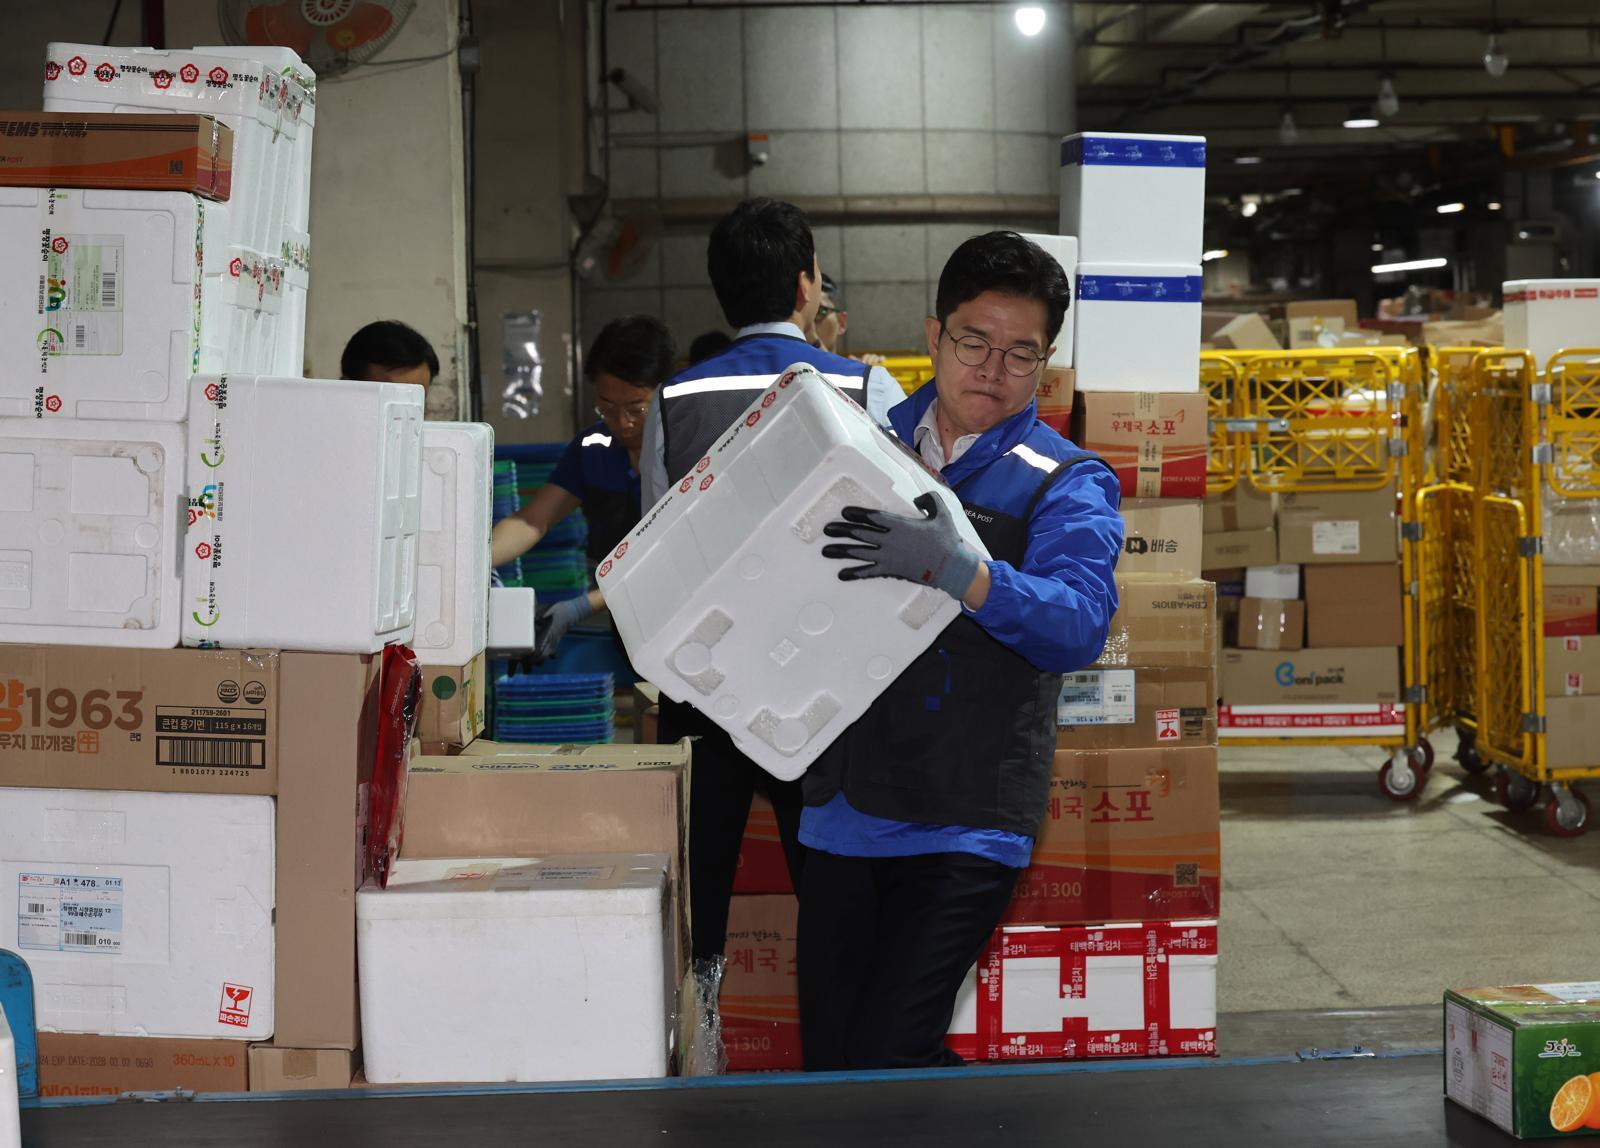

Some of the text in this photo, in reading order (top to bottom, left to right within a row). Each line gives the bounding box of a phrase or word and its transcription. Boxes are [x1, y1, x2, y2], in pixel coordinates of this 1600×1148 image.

[6, 121, 41, 137] EMS
[41, 228, 51, 261] 평창꽃순이
[217, 376, 228, 409] 평창꽃순이
[35, 386, 44, 419] 평창꽃순이
[1111, 419, 1177, 435] 우체국 소포
[976, 513, 994, 523] POST
[212, 534, 222, 568] 평창꽃순이
[1150, 539, 1178, 553] 배송
[162, 718, 178, 729] 큰컵
[180, 719, 205, 731] 용기면
[215, 722, 228, 730] 115
[31, 734, 76, 752] 파개장
[1090, 791, 1154, 823] 소포
[60, 878, 71, 886] A1
[81, 880, 96, 888] 478
[98, 938, 112, 946] 010
[1070, 940, 1121, 952] 태백하늘김치
[1147, 930, 1158, 980] 태백하늘김치
[988, 952, 1000, 1002] 태백하늘김치
[219, 1012, 249, 1026] 파손주의
[1087, 1042, 1138, 1054] 태백하늘김치
[1544, 1038, 1577, 1057] Jeju
[172, 1054, 210, 1067] 360mL
[223, 1055, 235, 1068] 10
